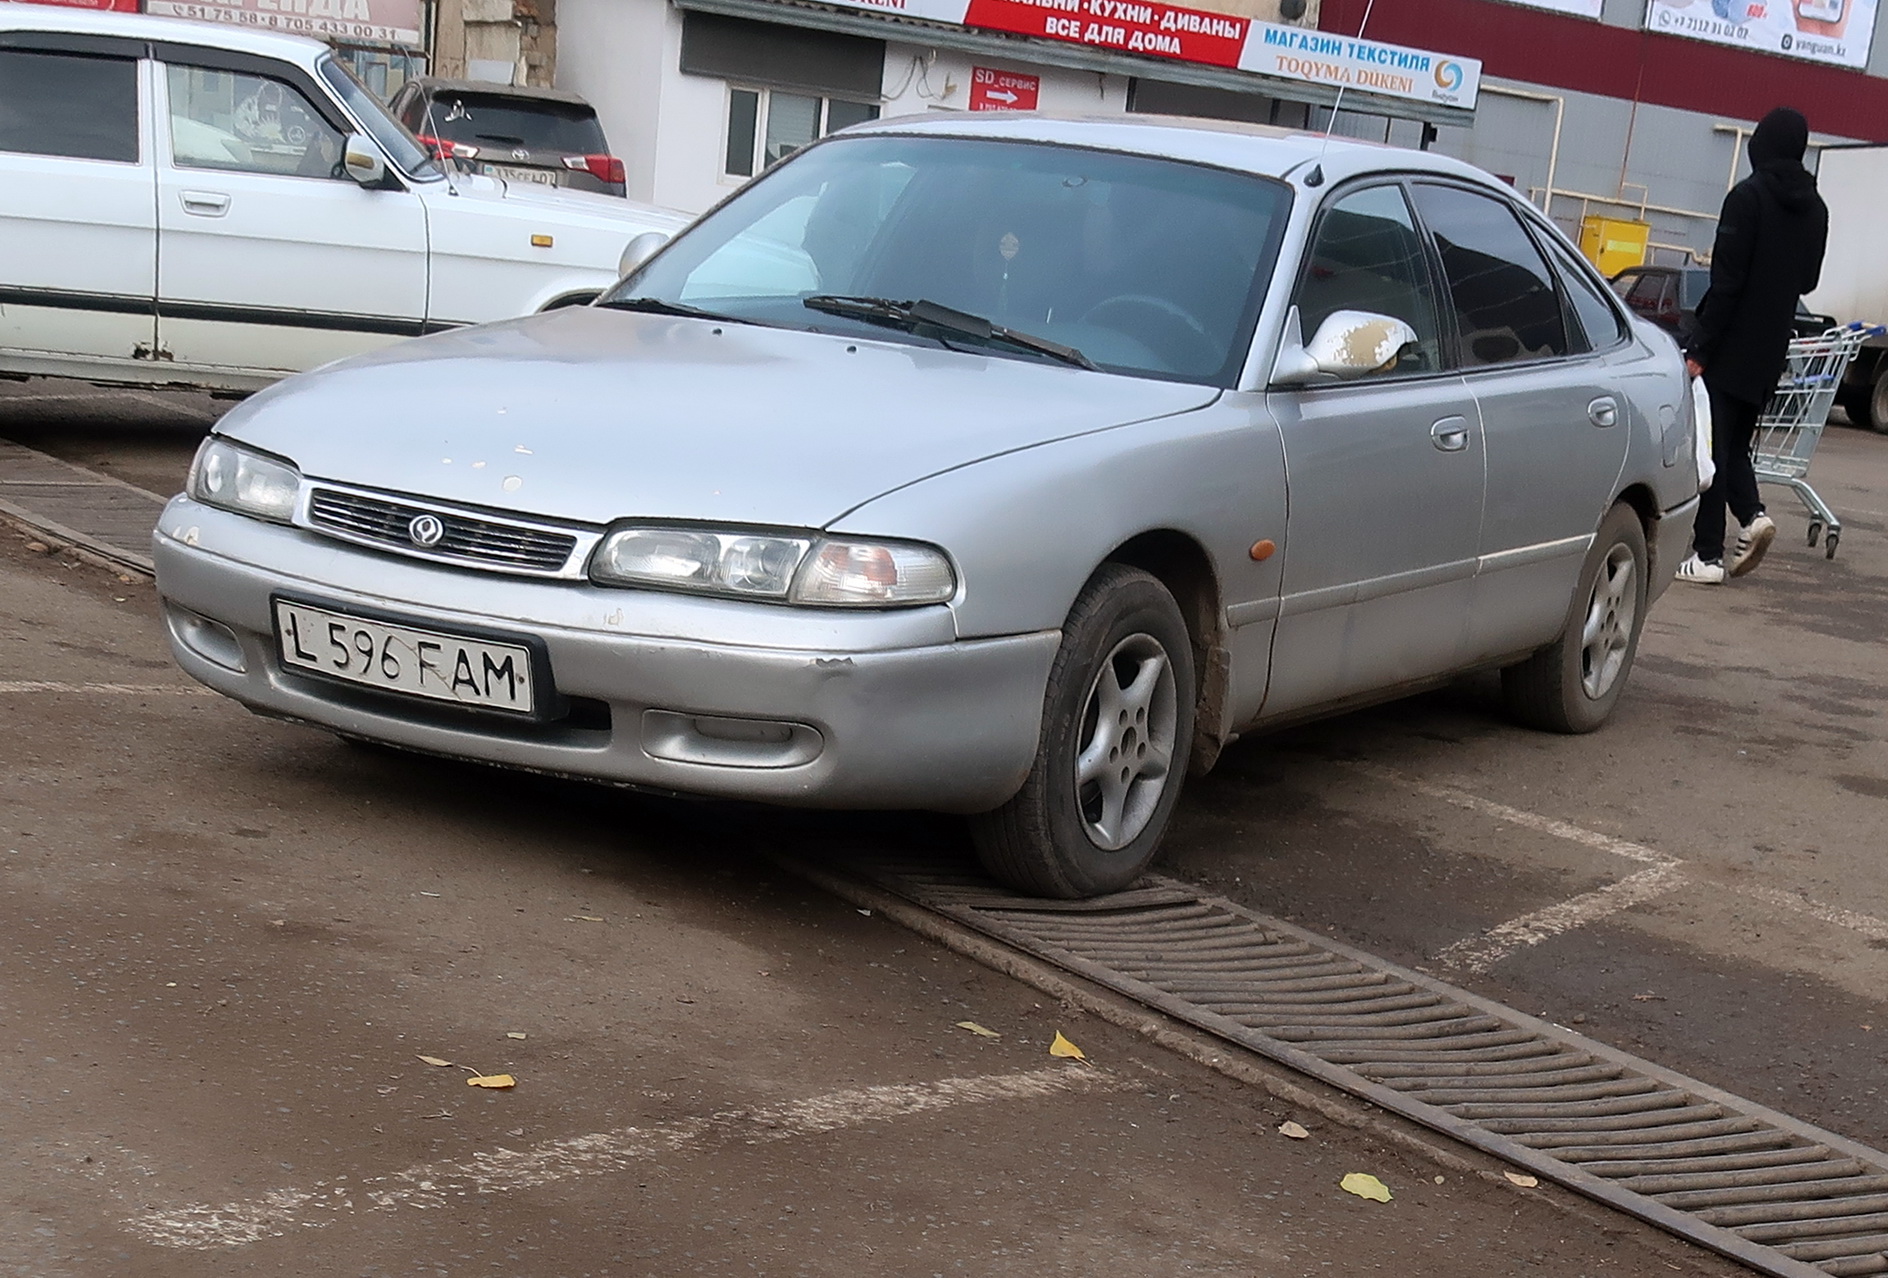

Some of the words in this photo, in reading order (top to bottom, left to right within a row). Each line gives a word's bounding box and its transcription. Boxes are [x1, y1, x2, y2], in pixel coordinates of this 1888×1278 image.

[187, 5, 205, 18] 51
[213, 8, 233, 20] 75
[239, 11, 258, 24] 58
[268, 15, 278, 26] 8
[284, 16, 313, 30] 705
[319, 21, 348, 34] 433
[354, 25, 373, 37] 00
[378, 27, 396, 40] 31
[1045, 16, 1080, 38] ВСЕ
[1084, 23, 1124, 45] ДЛЯ
[1128, 32, 1181, 54] ДОМА
[1089, 1, 1151, 25] КУХНИ
[1160, 10, 1241, 40] ДИВАНЫ
[1264, 28, 1342, 56] МАГАЗИН
[1348, 42, 1431, 72] ТЕКСТИЛЯ
[1276, 55, 1351, 83] TOQYMA
[289, 611, 318, 663] L
[328, 622, 400, 680] 596
[418, 640, 516, 700] FAM
